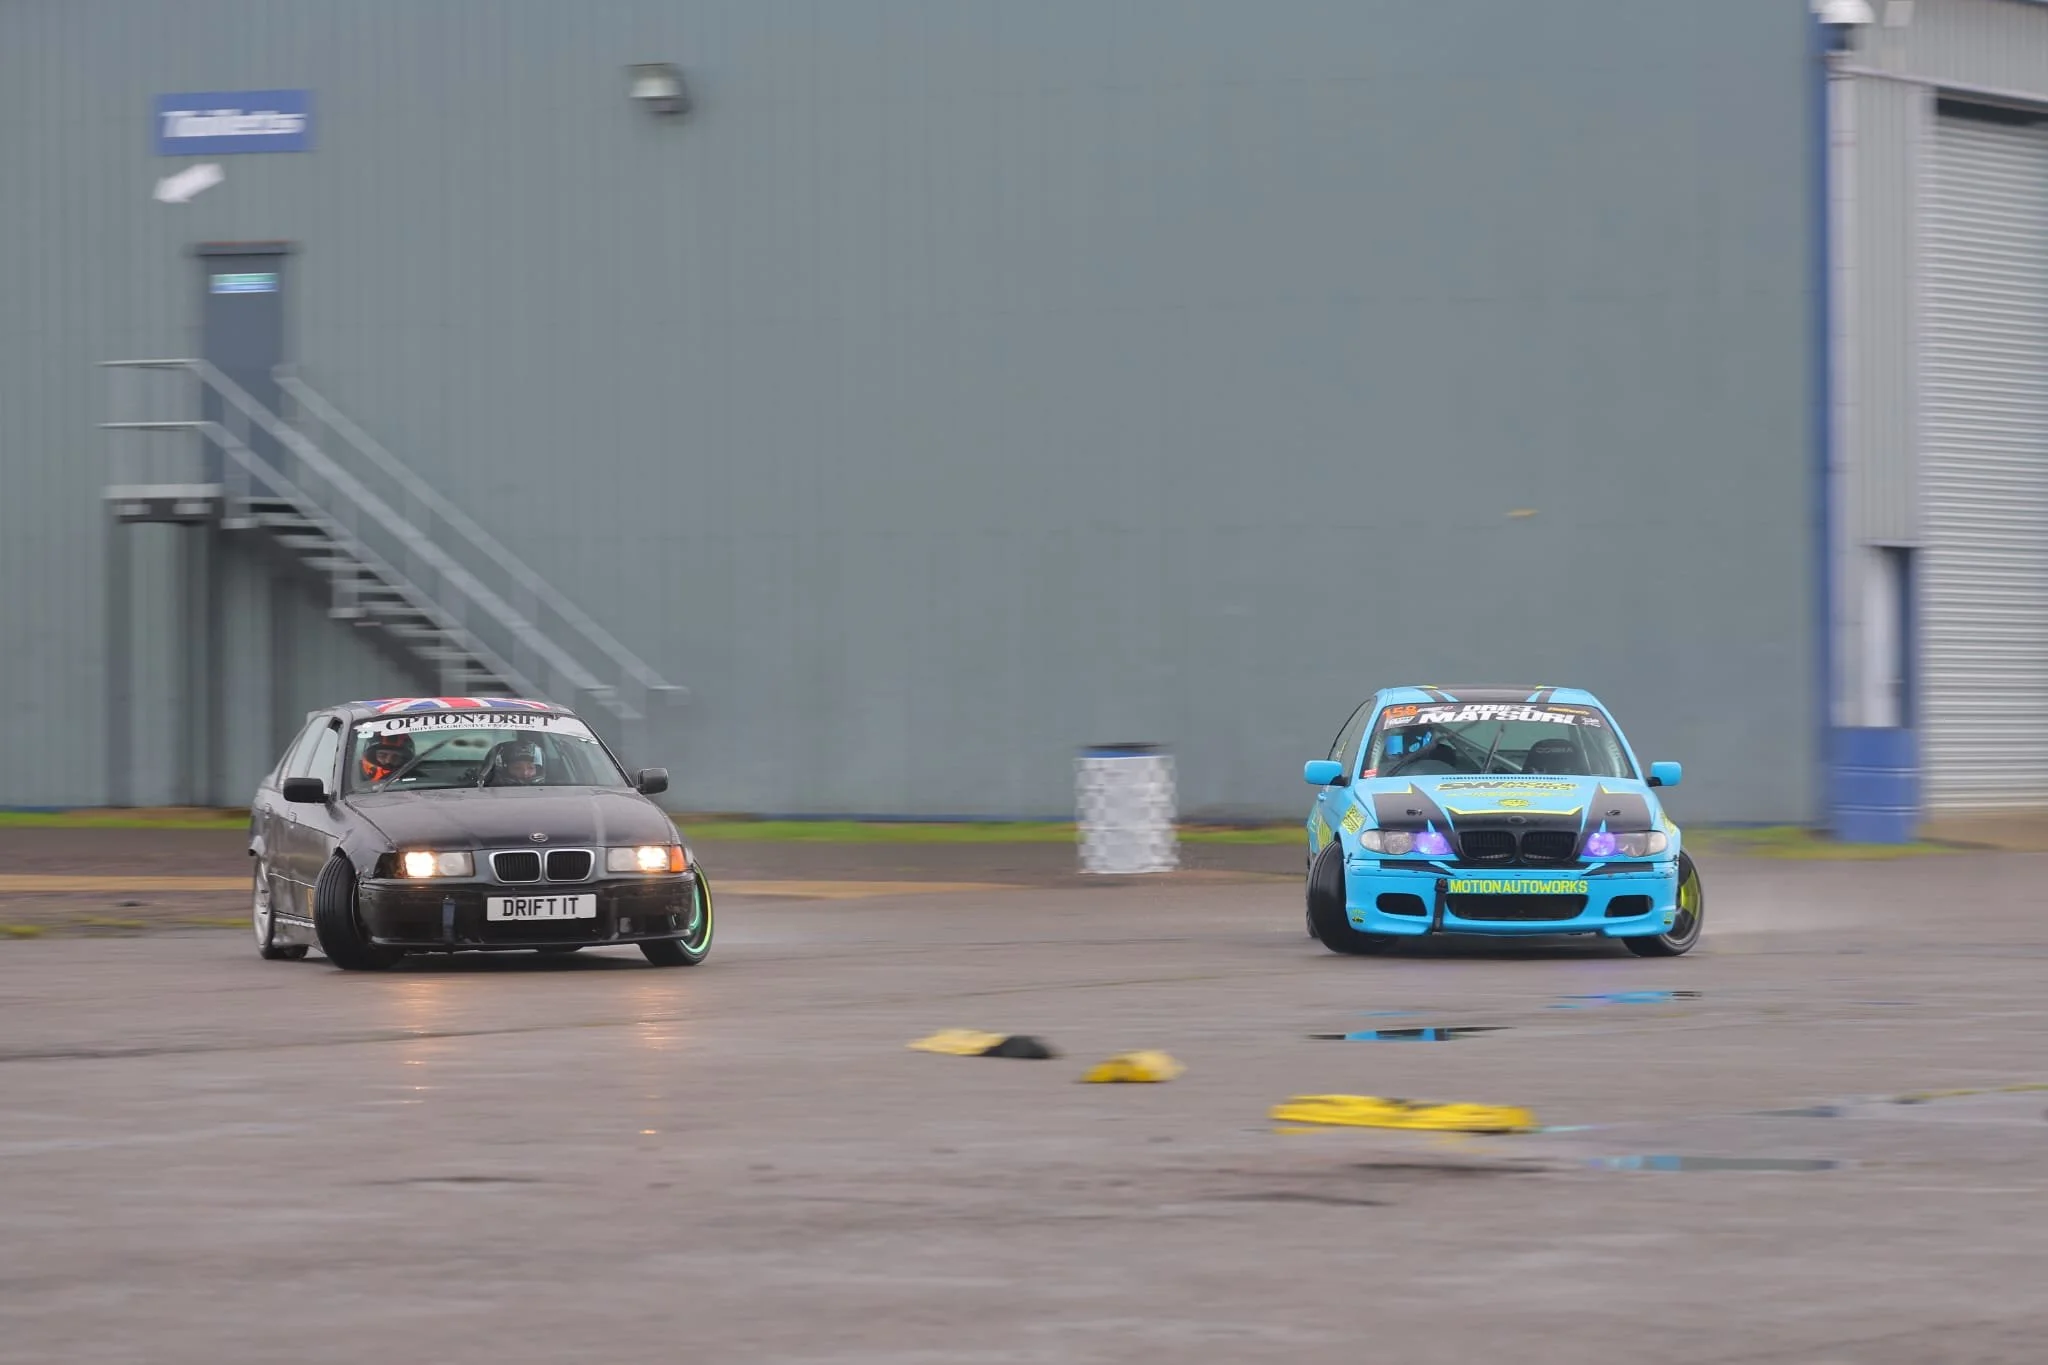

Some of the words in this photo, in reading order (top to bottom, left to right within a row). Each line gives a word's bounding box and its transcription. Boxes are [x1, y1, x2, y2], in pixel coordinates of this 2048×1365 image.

[1460, 704, 1537, 712] DRIFT
[386, 714, 475, 730] OPTION
[489, 713, 552, 726] DRIFT
[1419, 711, 1577, 725] MATSURI
[503, 898, 557, 916] DRIFT
[563, 897, 579, 915] IT
